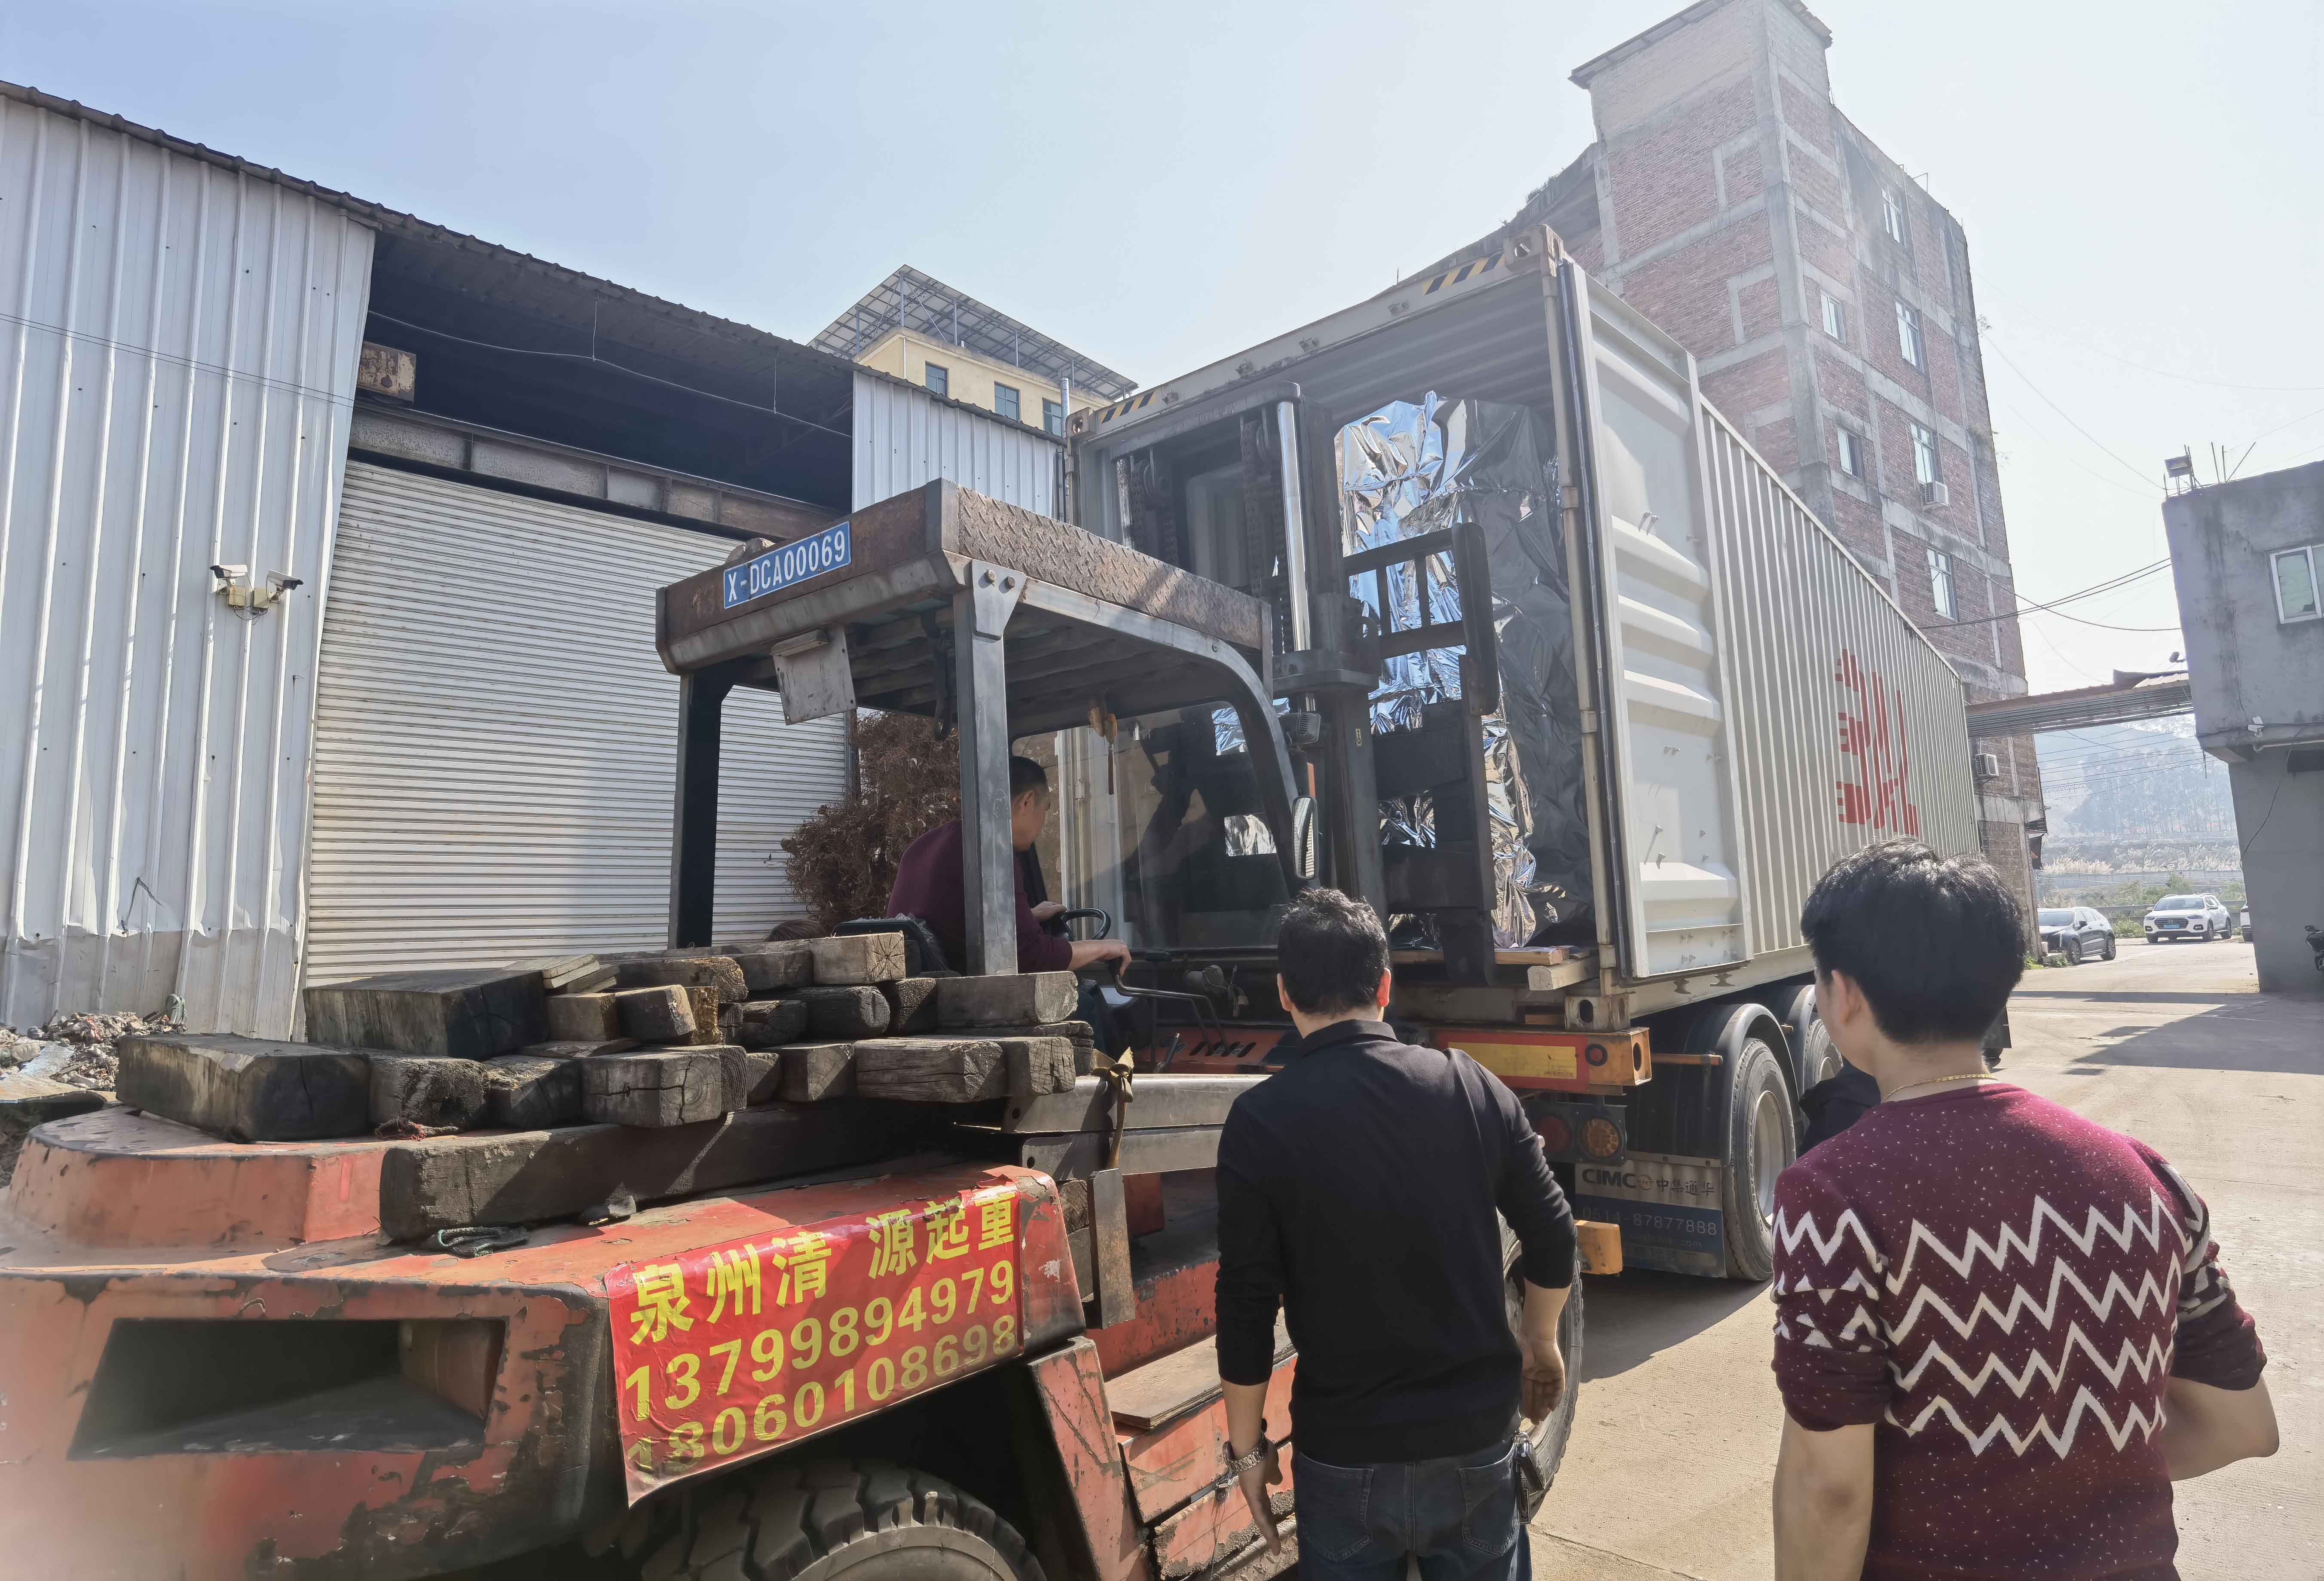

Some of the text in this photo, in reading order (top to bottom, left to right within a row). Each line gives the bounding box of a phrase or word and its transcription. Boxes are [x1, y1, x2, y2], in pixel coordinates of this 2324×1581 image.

[728, 530, 846, 602] X-DCA00069
[1582, 1168, 1636, 1190] CIMC
[625, 1260, 1014, 1422] 13799894979
[627, 1315, 1016, 1483] 18060108698
